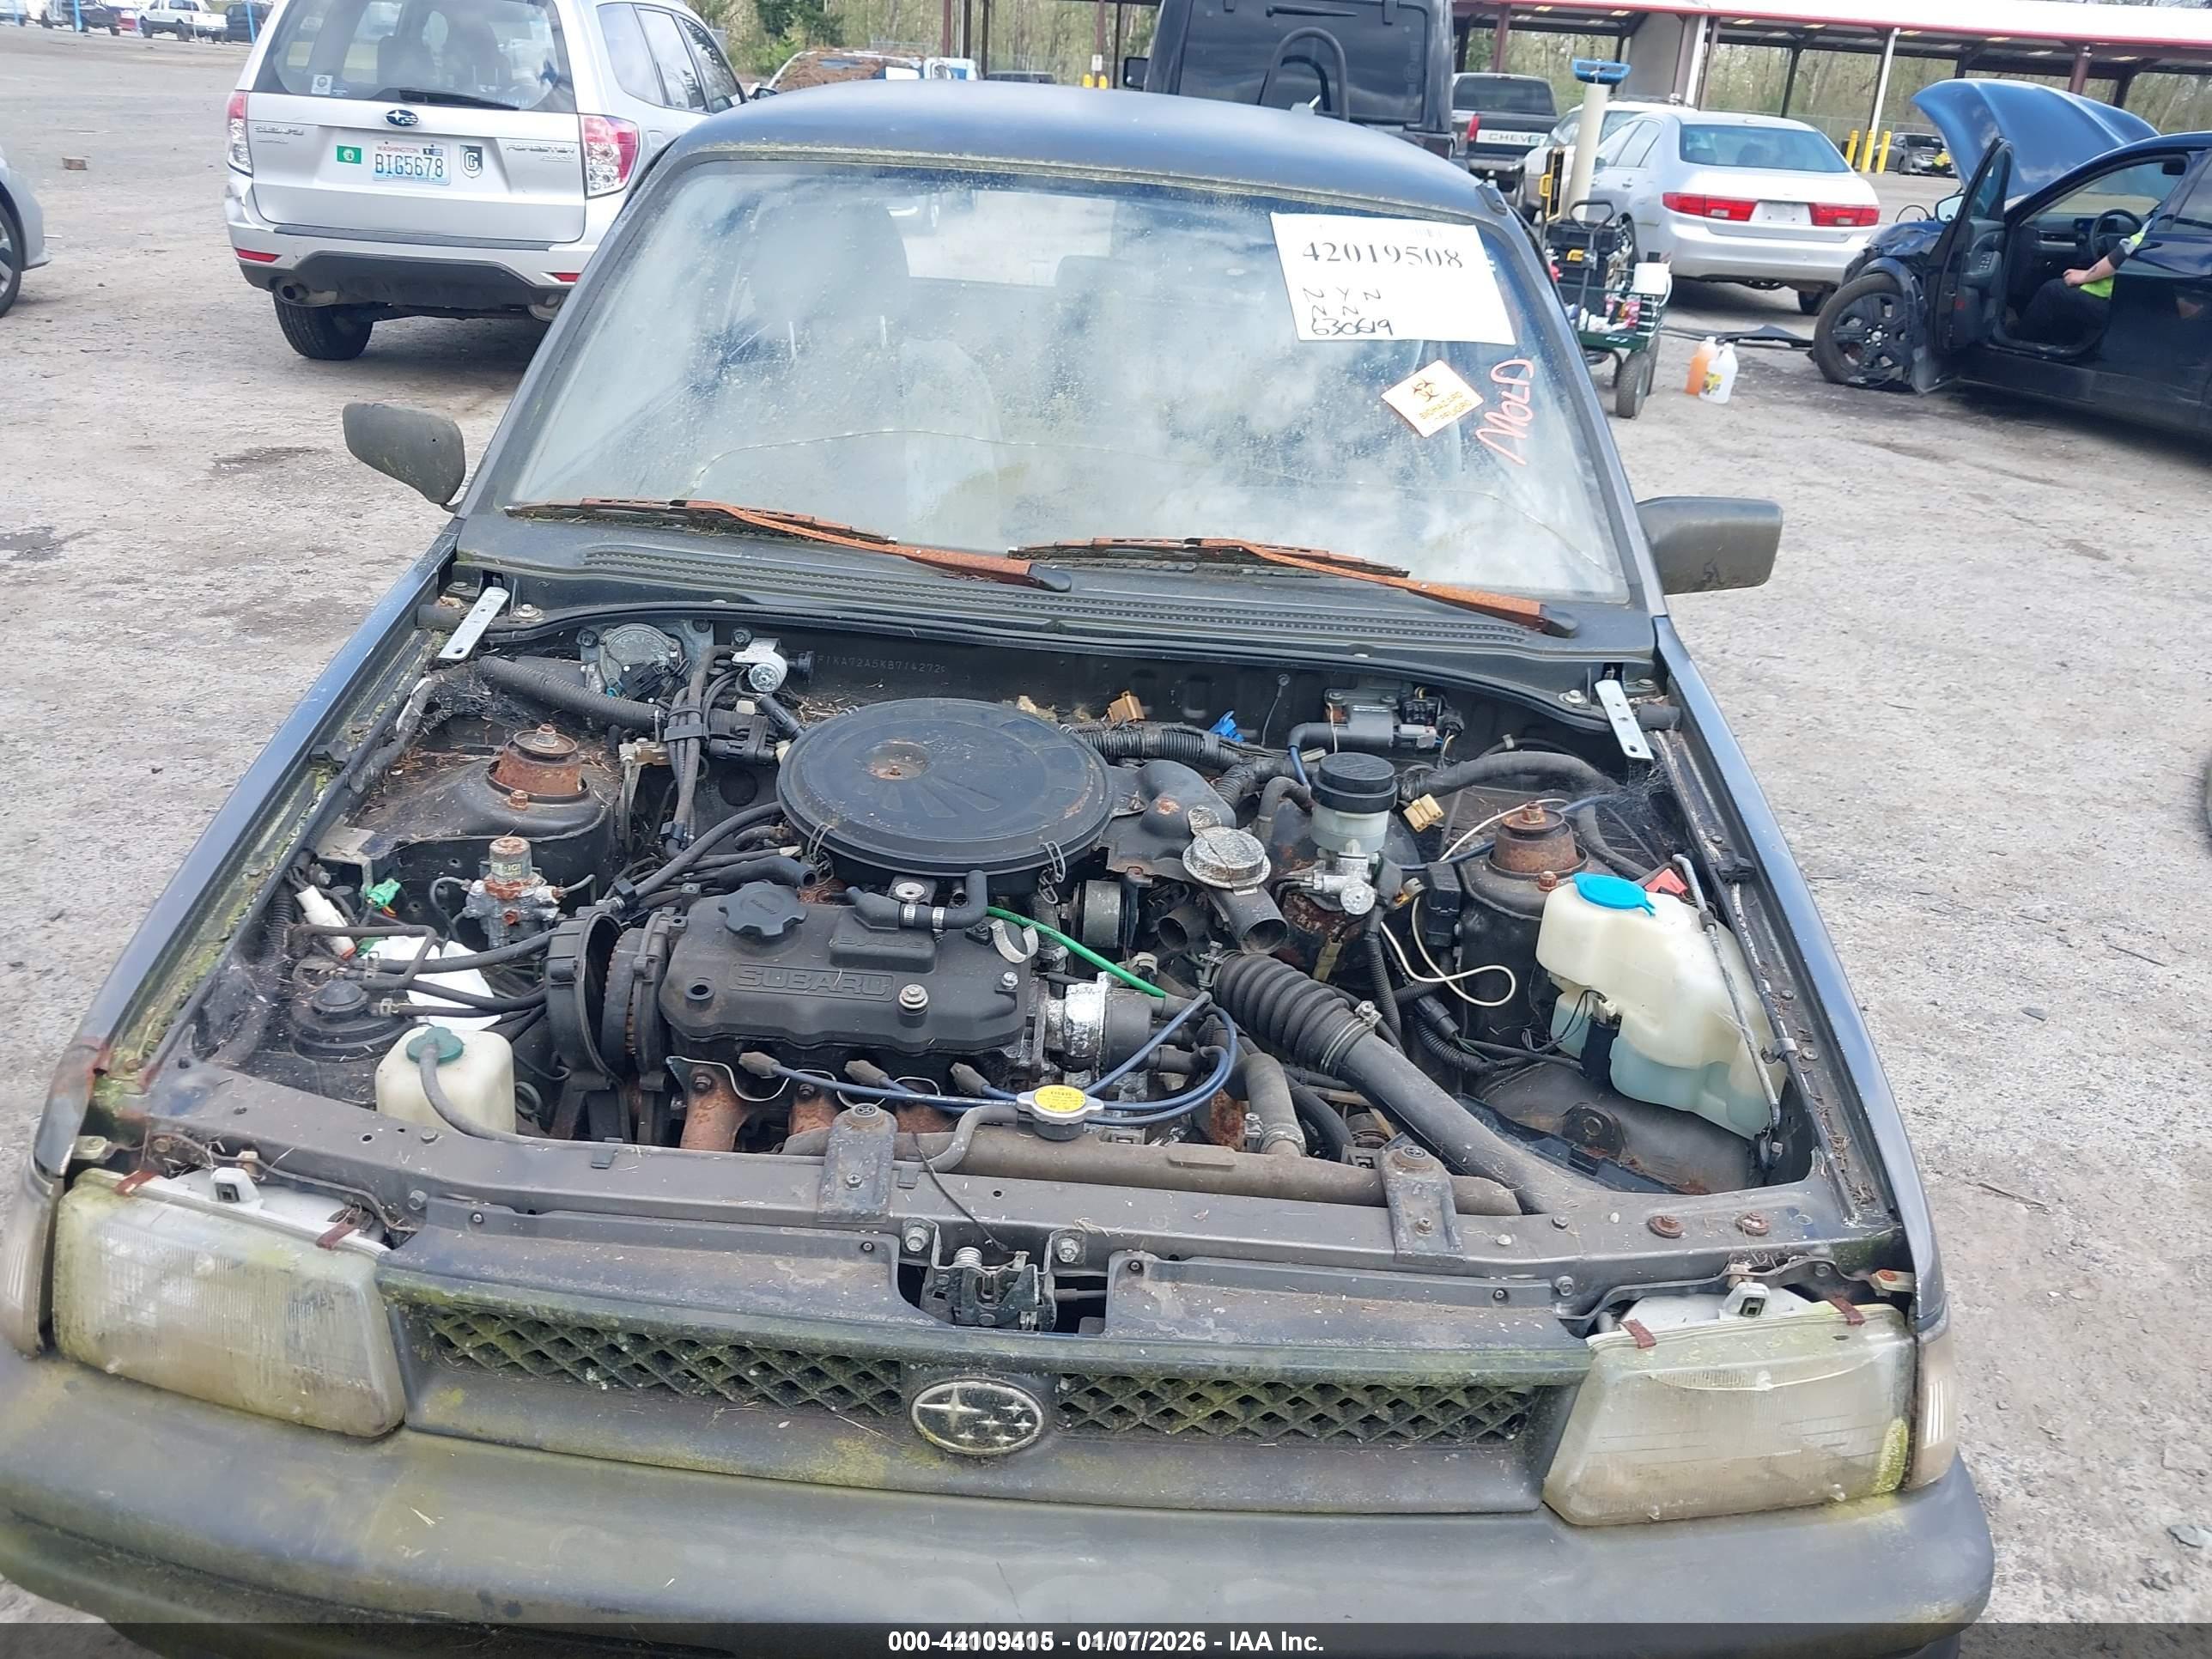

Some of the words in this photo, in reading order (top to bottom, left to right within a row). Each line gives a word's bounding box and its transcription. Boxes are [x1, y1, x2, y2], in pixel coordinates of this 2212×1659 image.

[506, 143, 574, 154] FORESTER
[374, 152, 444, 178] BIG5678
[1302, 241, 1463, 269] 42019508
[1311, 317, 1394, 337] 630619
[737, 968, 888, 997] SUBARU
